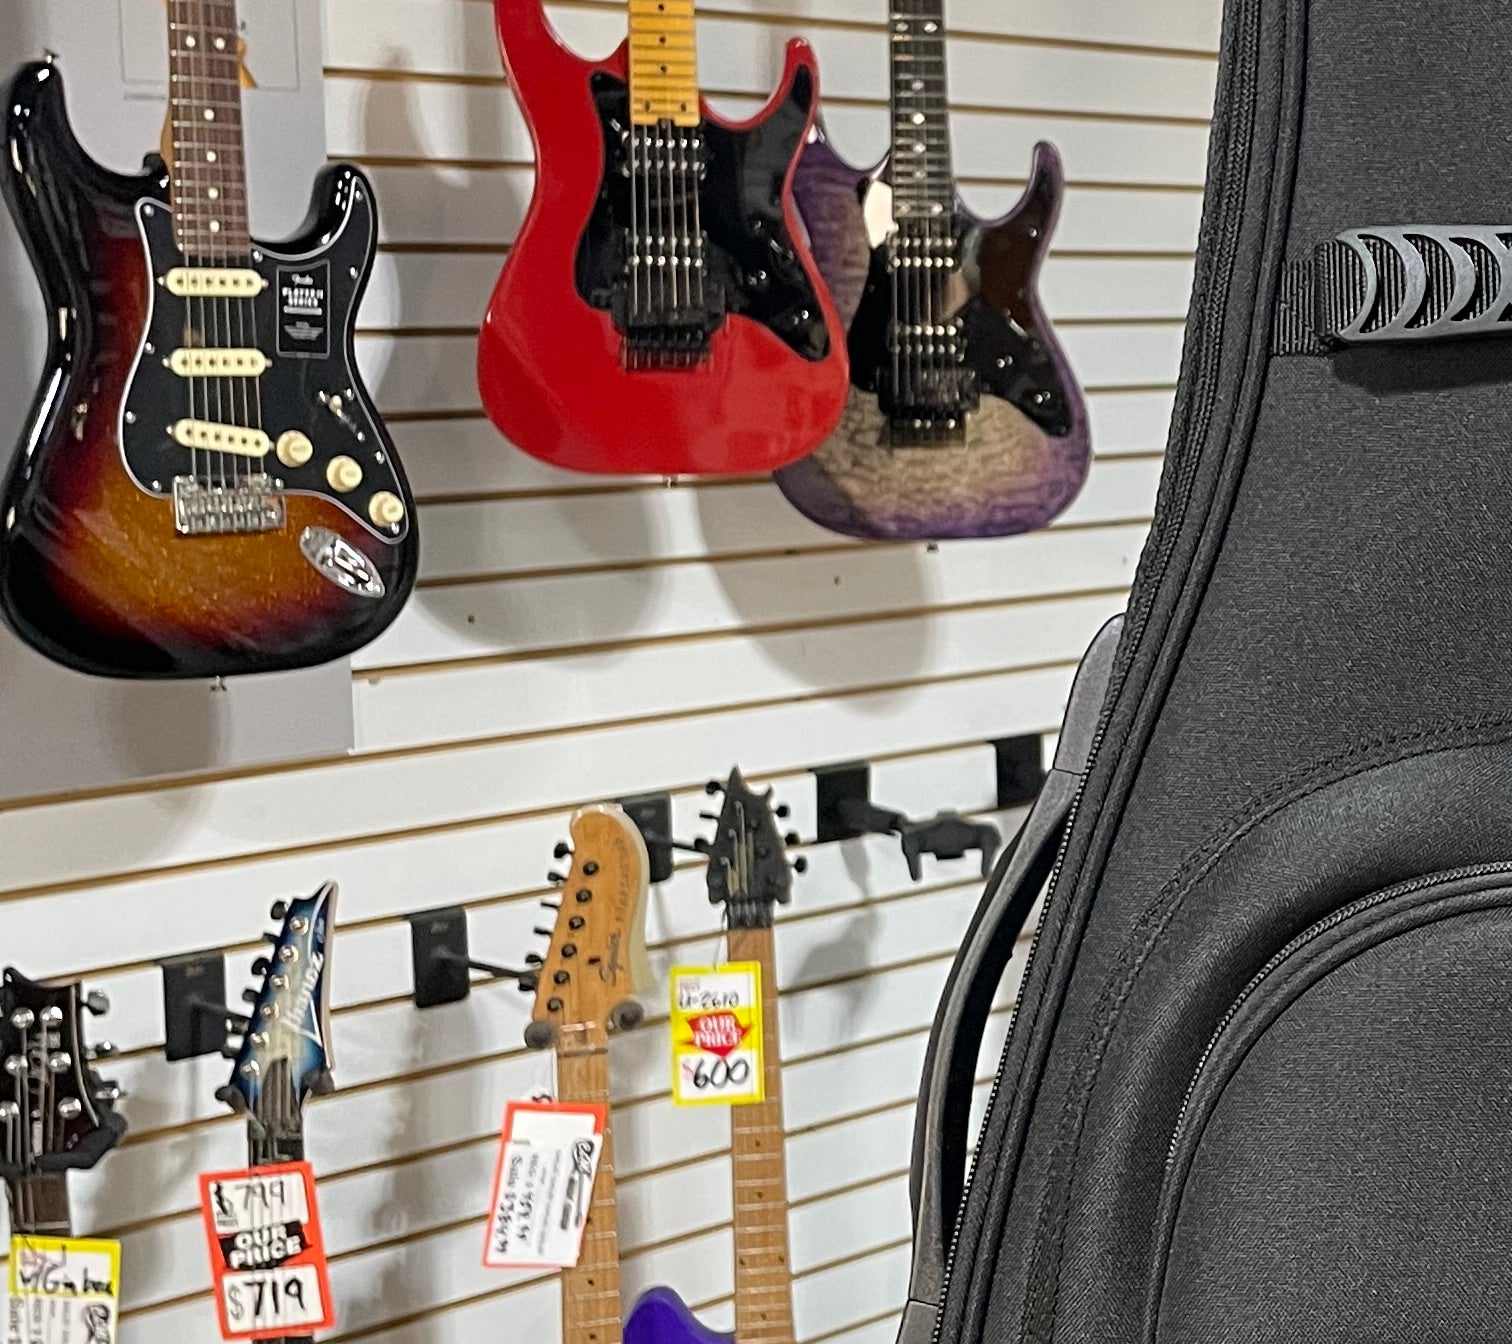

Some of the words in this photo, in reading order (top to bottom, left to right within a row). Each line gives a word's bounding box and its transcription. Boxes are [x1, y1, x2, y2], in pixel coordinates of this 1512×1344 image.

[699, 1015, 736, 1032] OUR
[693, 1029, 742, 1048] PRICE
[234, 1224, 288, 1250] OUR
[229, 1235, 302, 1270] PRICE
[228, 1277, 306, 1322] $719
